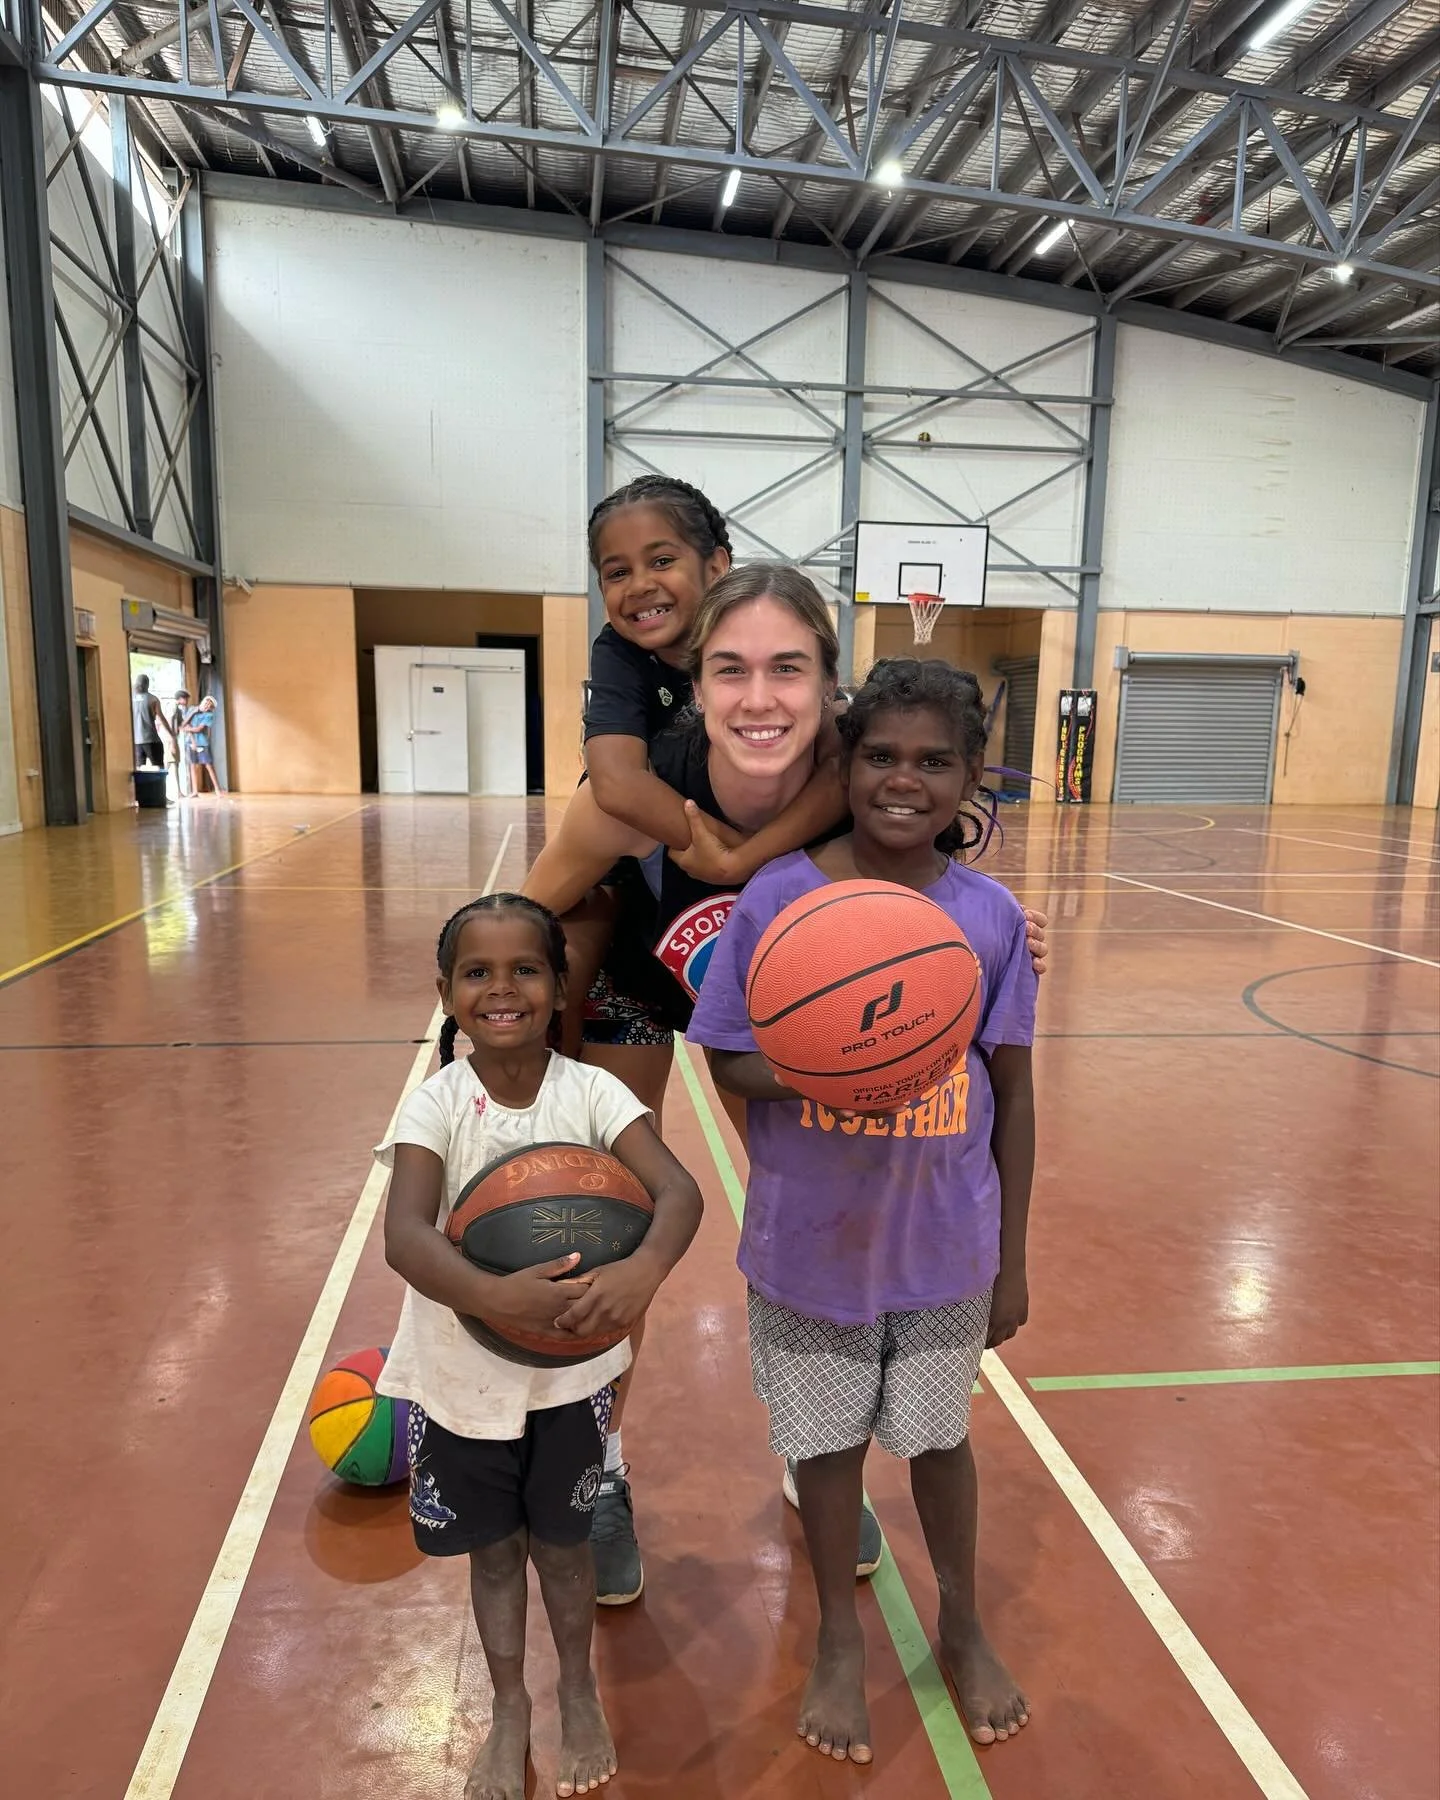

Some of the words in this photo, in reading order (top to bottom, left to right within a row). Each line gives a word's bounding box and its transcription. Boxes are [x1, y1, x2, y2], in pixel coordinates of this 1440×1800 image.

[1074, 726, 1086, 785] PROGRAMS
[669, 906, 732, 956] SPOR
[841, 1037, 877, 1055] PRO
[881, 1009, 935, 1040] TOUCH
[852, 1083, 895, 1094] OFFICIAL
[896, 1069, 924, 1086] TOUCH
[926, 1043, 957, 1071] CONTROL
[854, 1048, 959, 1102] HARLEM
[505, 1153, 641, 1190] ALDING
[410, 1506, 448, 1532] TORM
